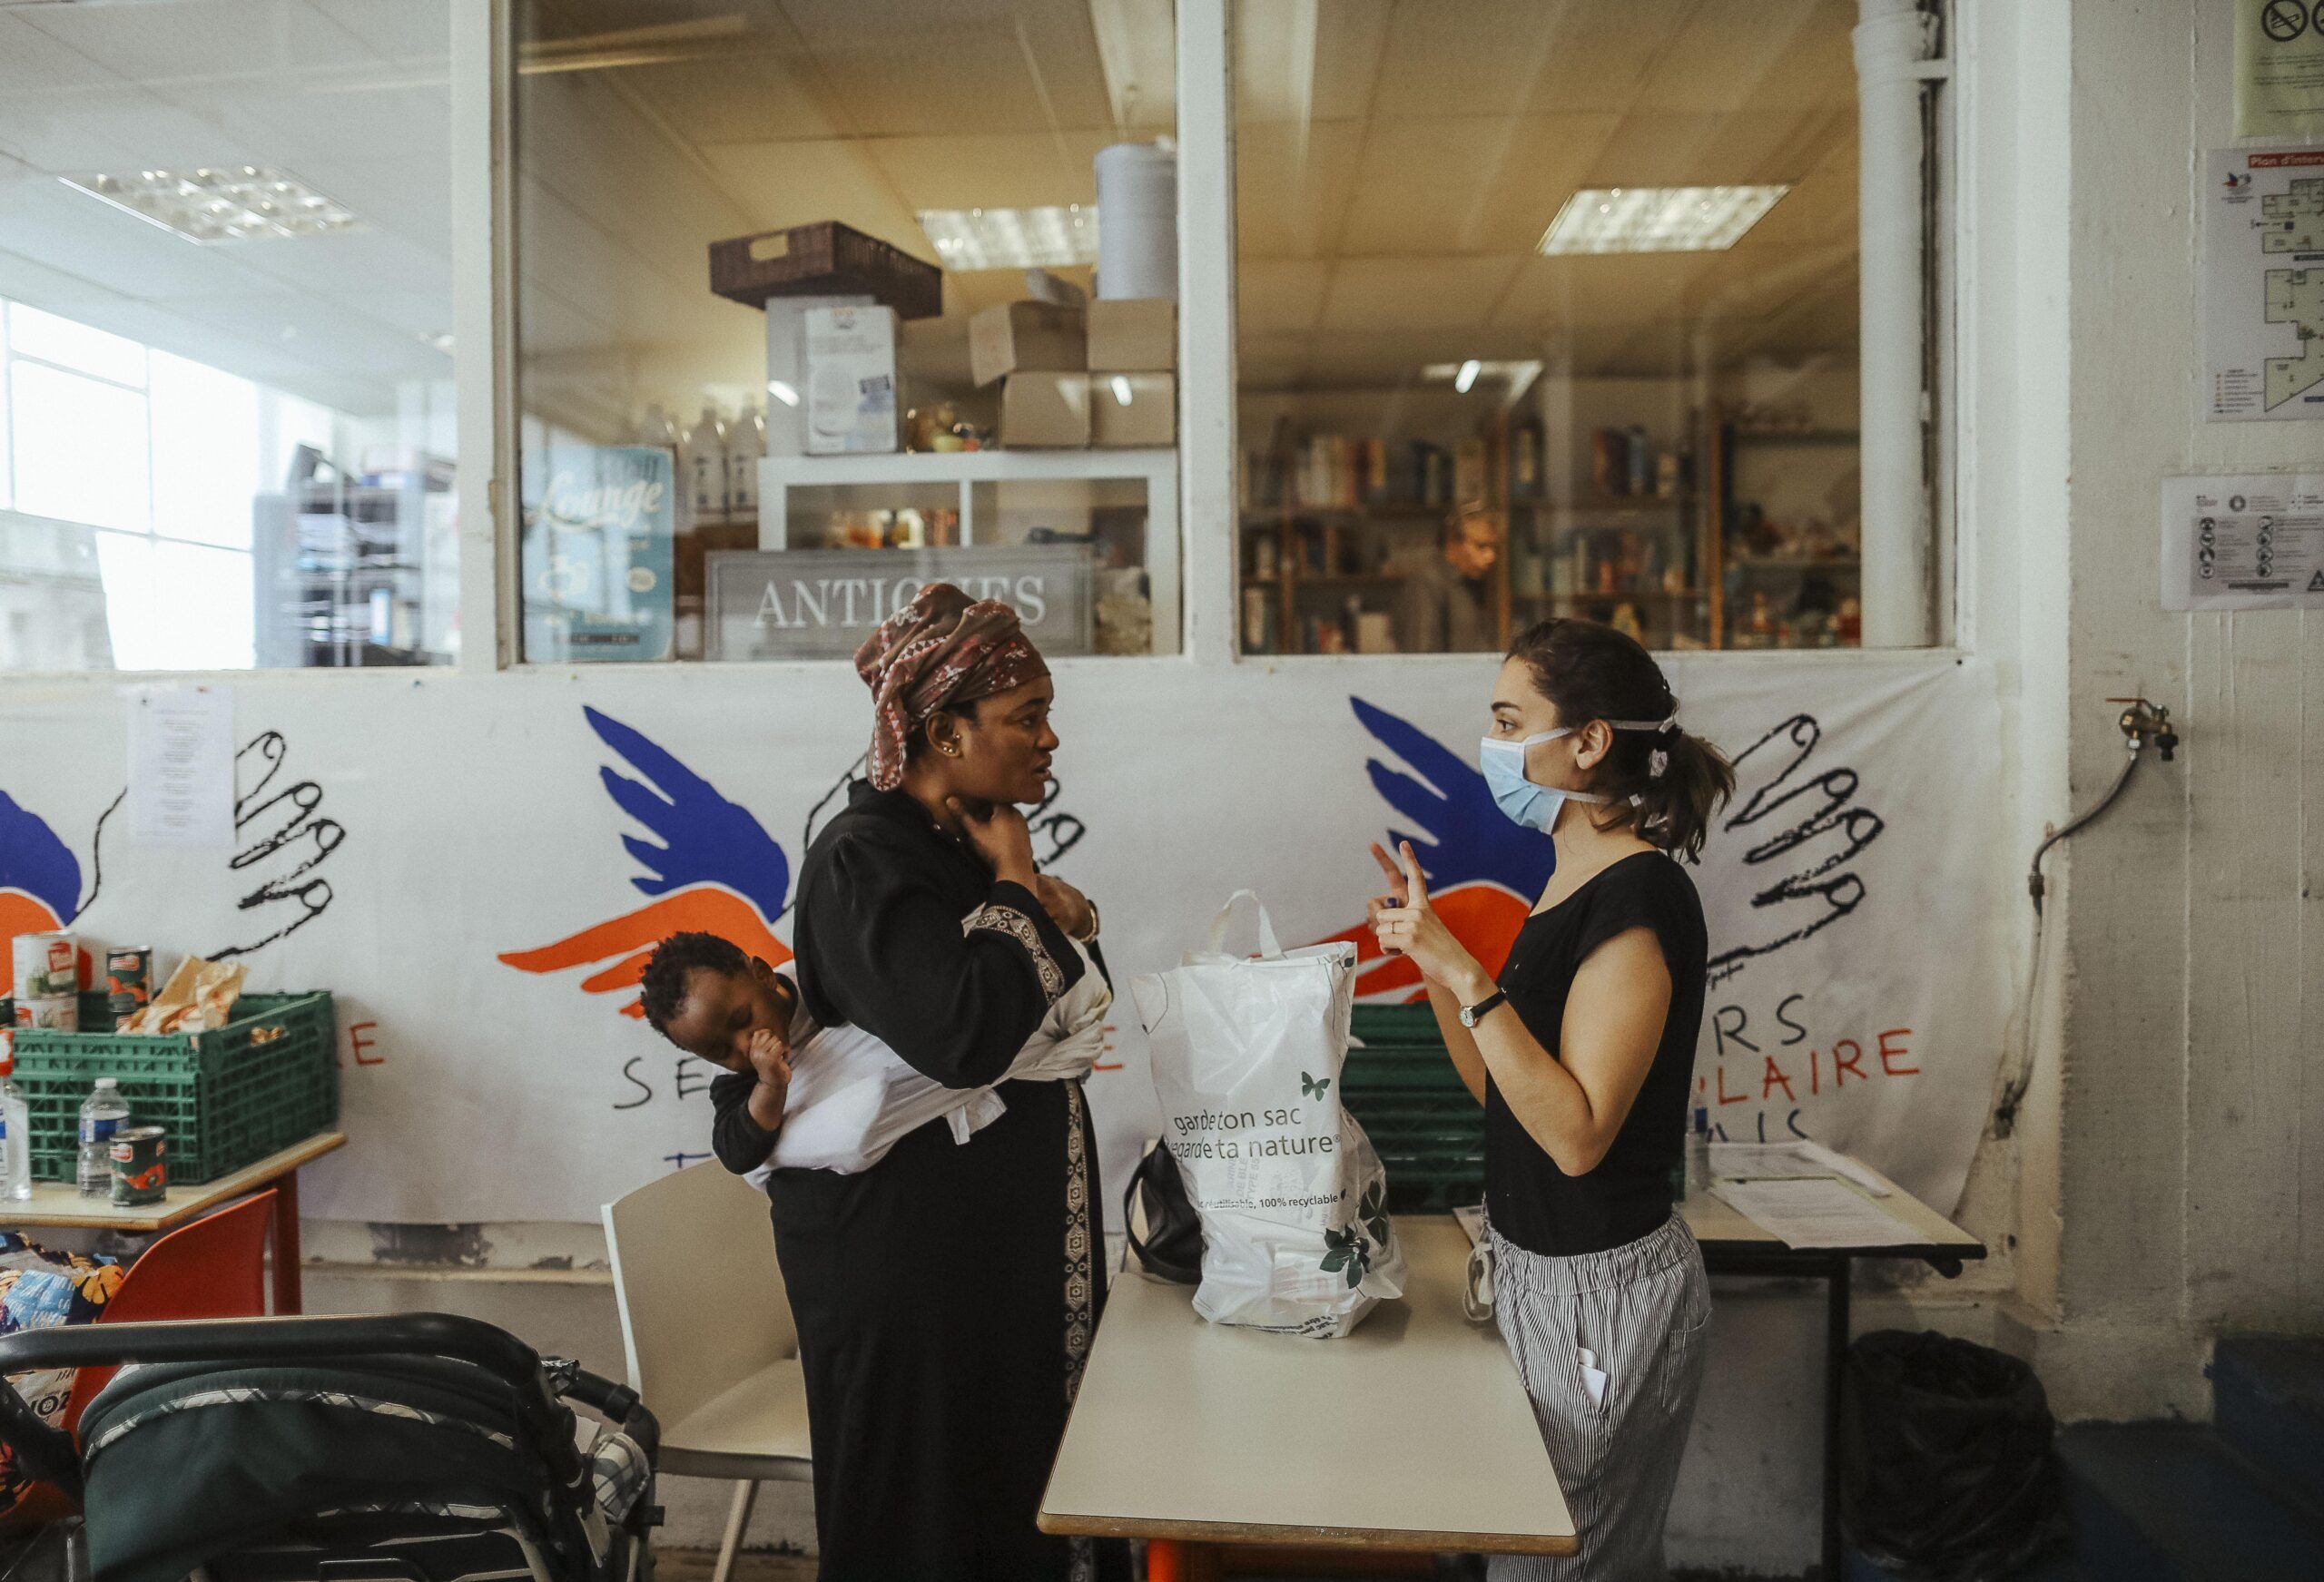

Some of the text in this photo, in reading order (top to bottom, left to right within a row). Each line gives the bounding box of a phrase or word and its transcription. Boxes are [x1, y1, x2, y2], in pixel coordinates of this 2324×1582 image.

[753, 575, 1046, 628] ANTIS
[1699, 1027, 1921, 1105] LAIRE
[1174, 1107, 1302, 1136] garde ton sac
[1168, 1136, 1213, 1163] egarde
[1216, 1139, 1239, 1160] ta
[1259, 1197, 1287, 1208] 100%
[1288, 1193, 1339, 1208] recyclable
